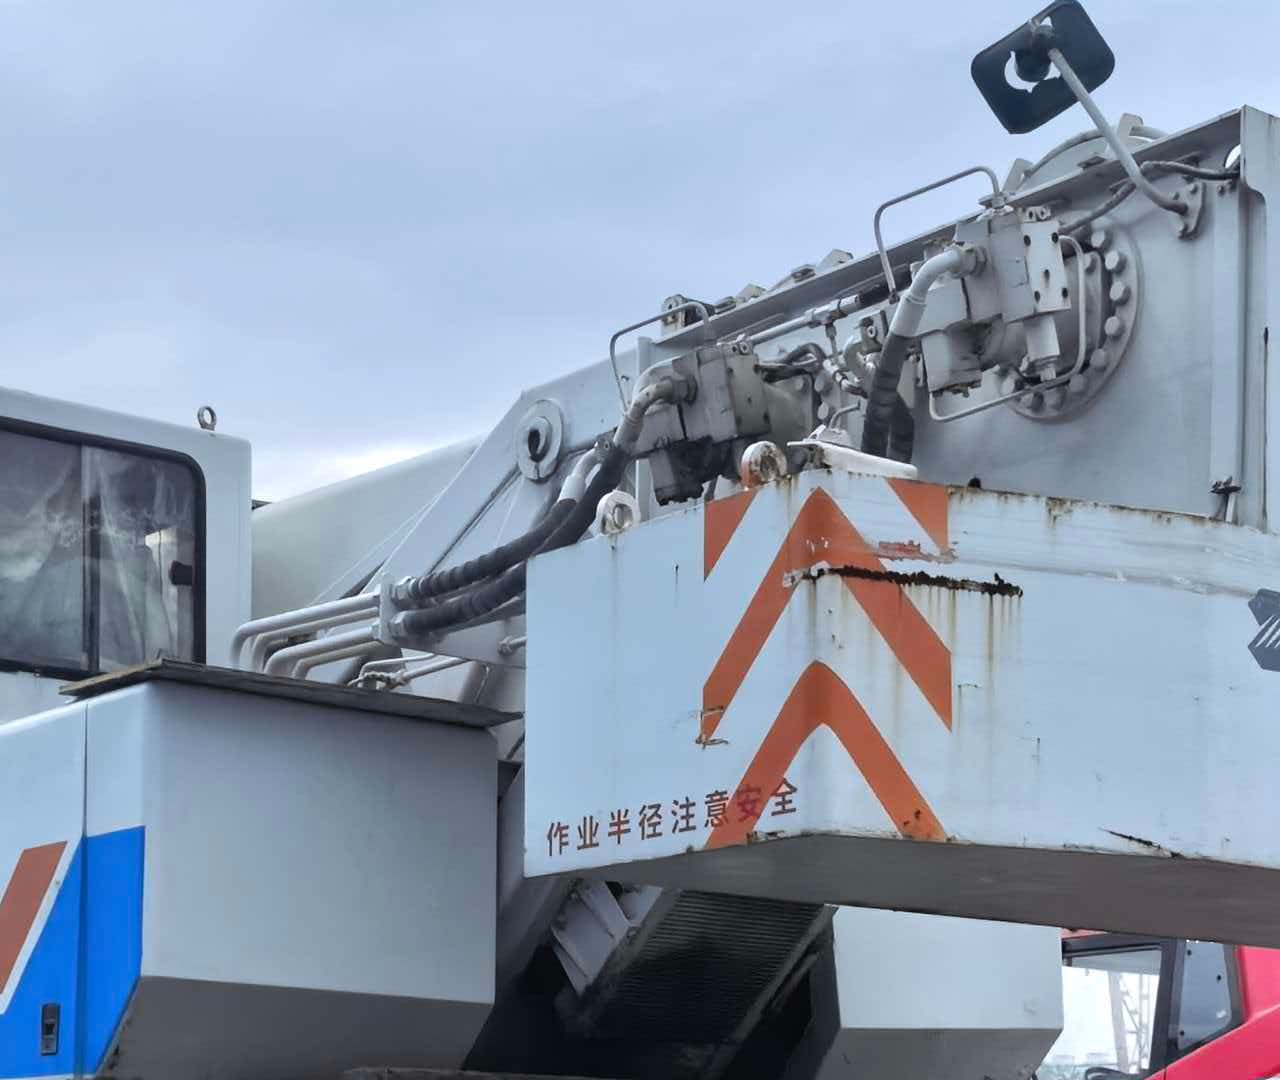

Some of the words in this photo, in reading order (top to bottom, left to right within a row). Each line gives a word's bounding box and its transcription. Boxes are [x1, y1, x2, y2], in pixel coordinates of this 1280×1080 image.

[547, 777, 798, 856] 作业半径注意安全
